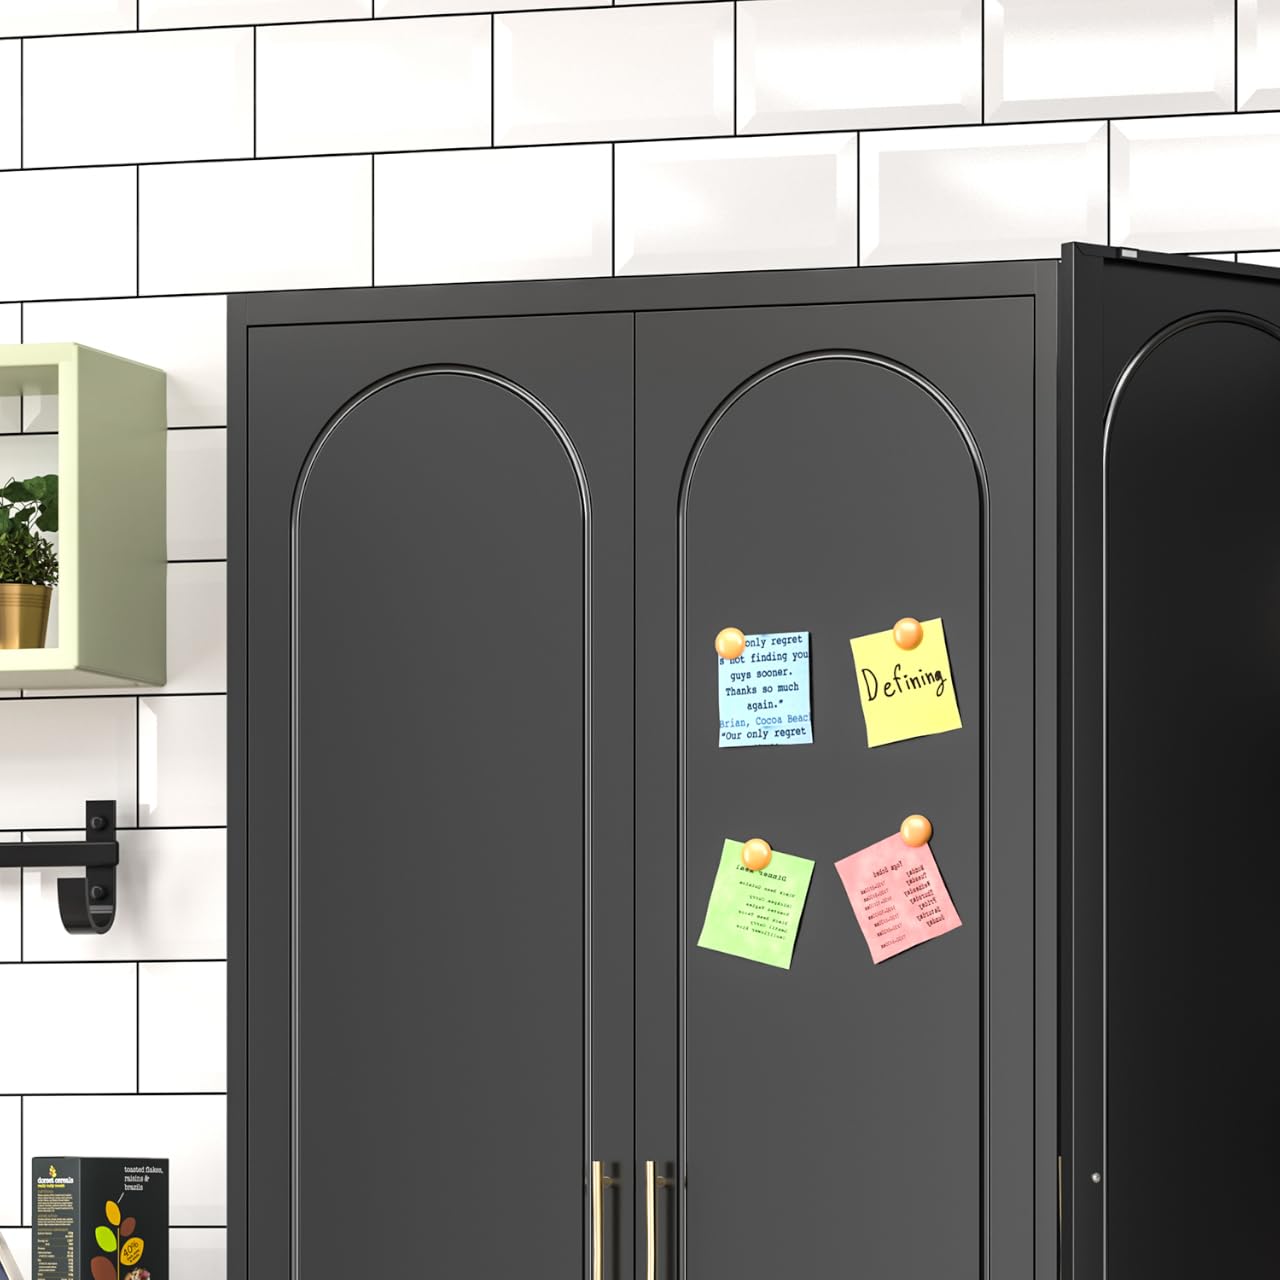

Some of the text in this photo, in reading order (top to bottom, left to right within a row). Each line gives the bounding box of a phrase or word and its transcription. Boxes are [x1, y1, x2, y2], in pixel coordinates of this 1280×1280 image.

[745, 635, 803, 648] only regret
[751, 652, 788, 663] finding
[792, 651, 809, 661] you
[730, 668, 792, 682] guys sooner.
[725, 682, 799, 696] Thanks so much
[862, 664, 947, 701] Defining
[720, 714, 810, 728] Brian, Cocoa Beac
[746, 729, 768, 740] only
[774, 727, 806, 739] regret
[123, 1242, 138, 1256] 40%
